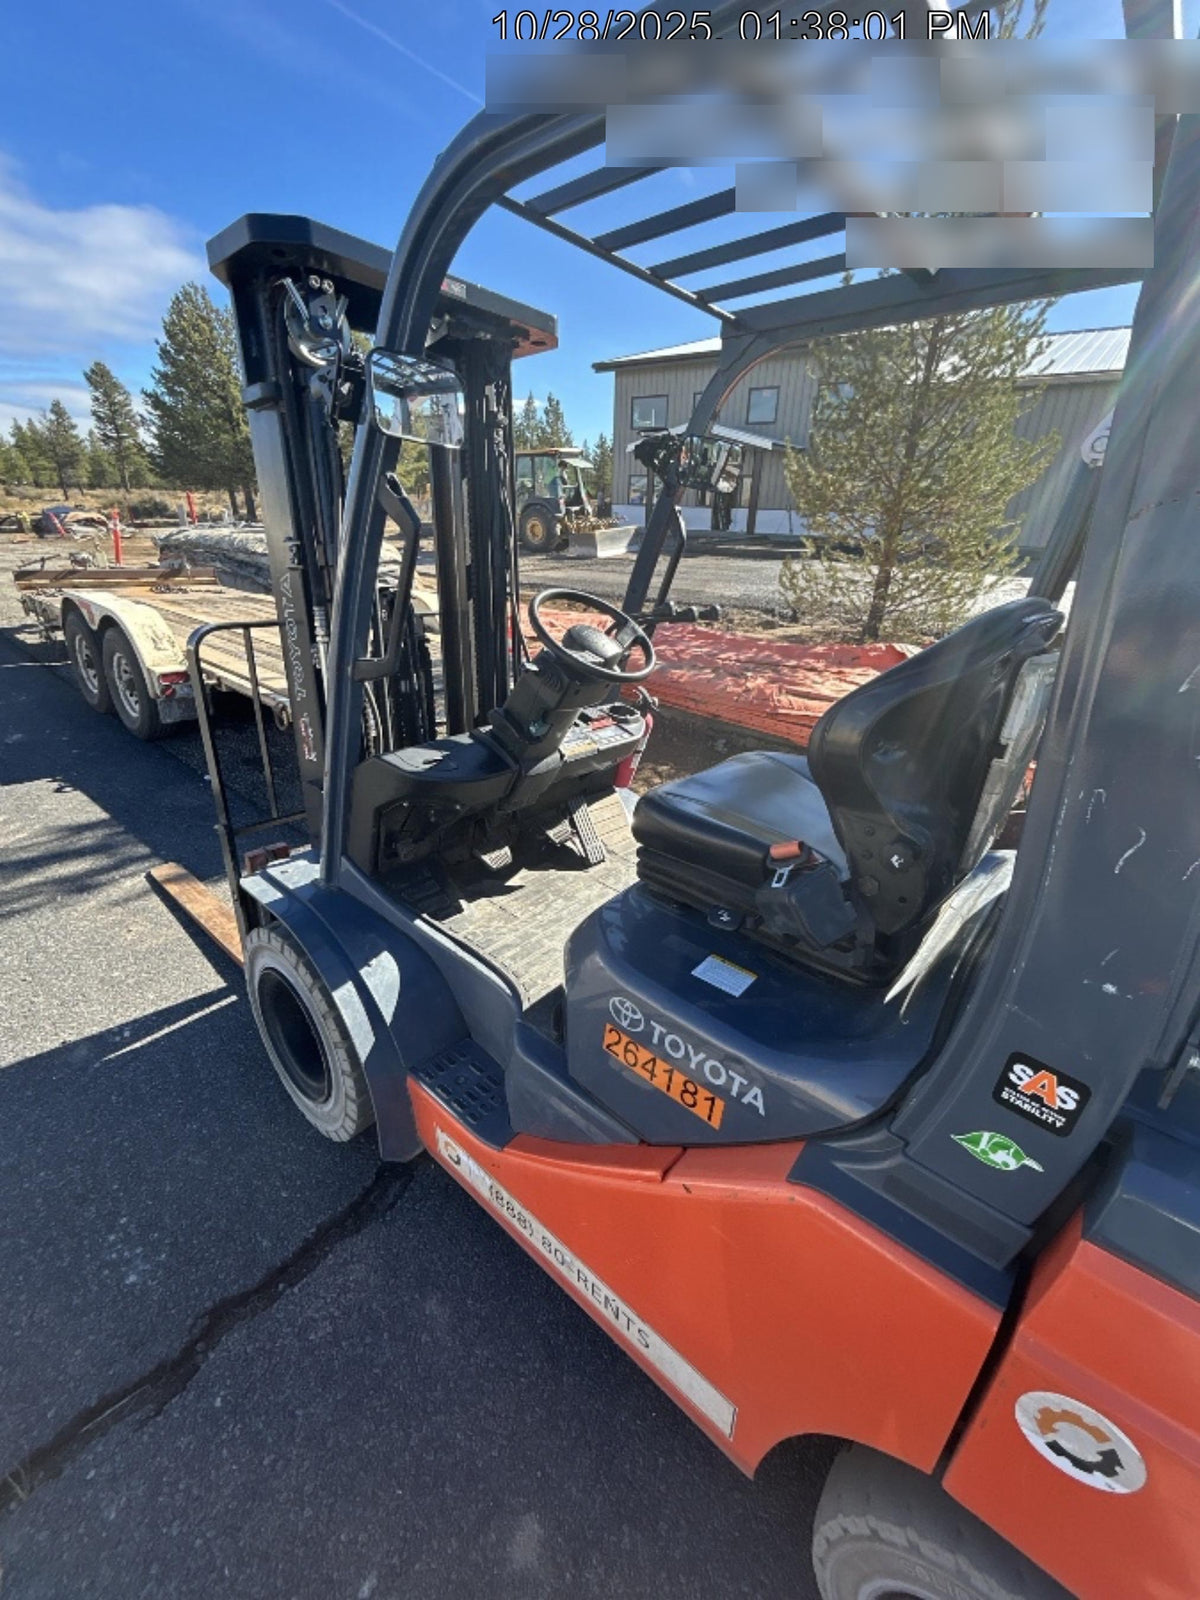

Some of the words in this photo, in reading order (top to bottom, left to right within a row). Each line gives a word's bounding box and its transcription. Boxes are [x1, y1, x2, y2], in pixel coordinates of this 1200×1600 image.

[605, 1028, 717, 1123] 264181
[650, 1020, 766, 1117] TOYOTA
[1008, 1063, 1080, 1110] SAS
[1001, 1091, 1064, 1128] STABILITY
[488, 1184, 534, 1237] (888)
